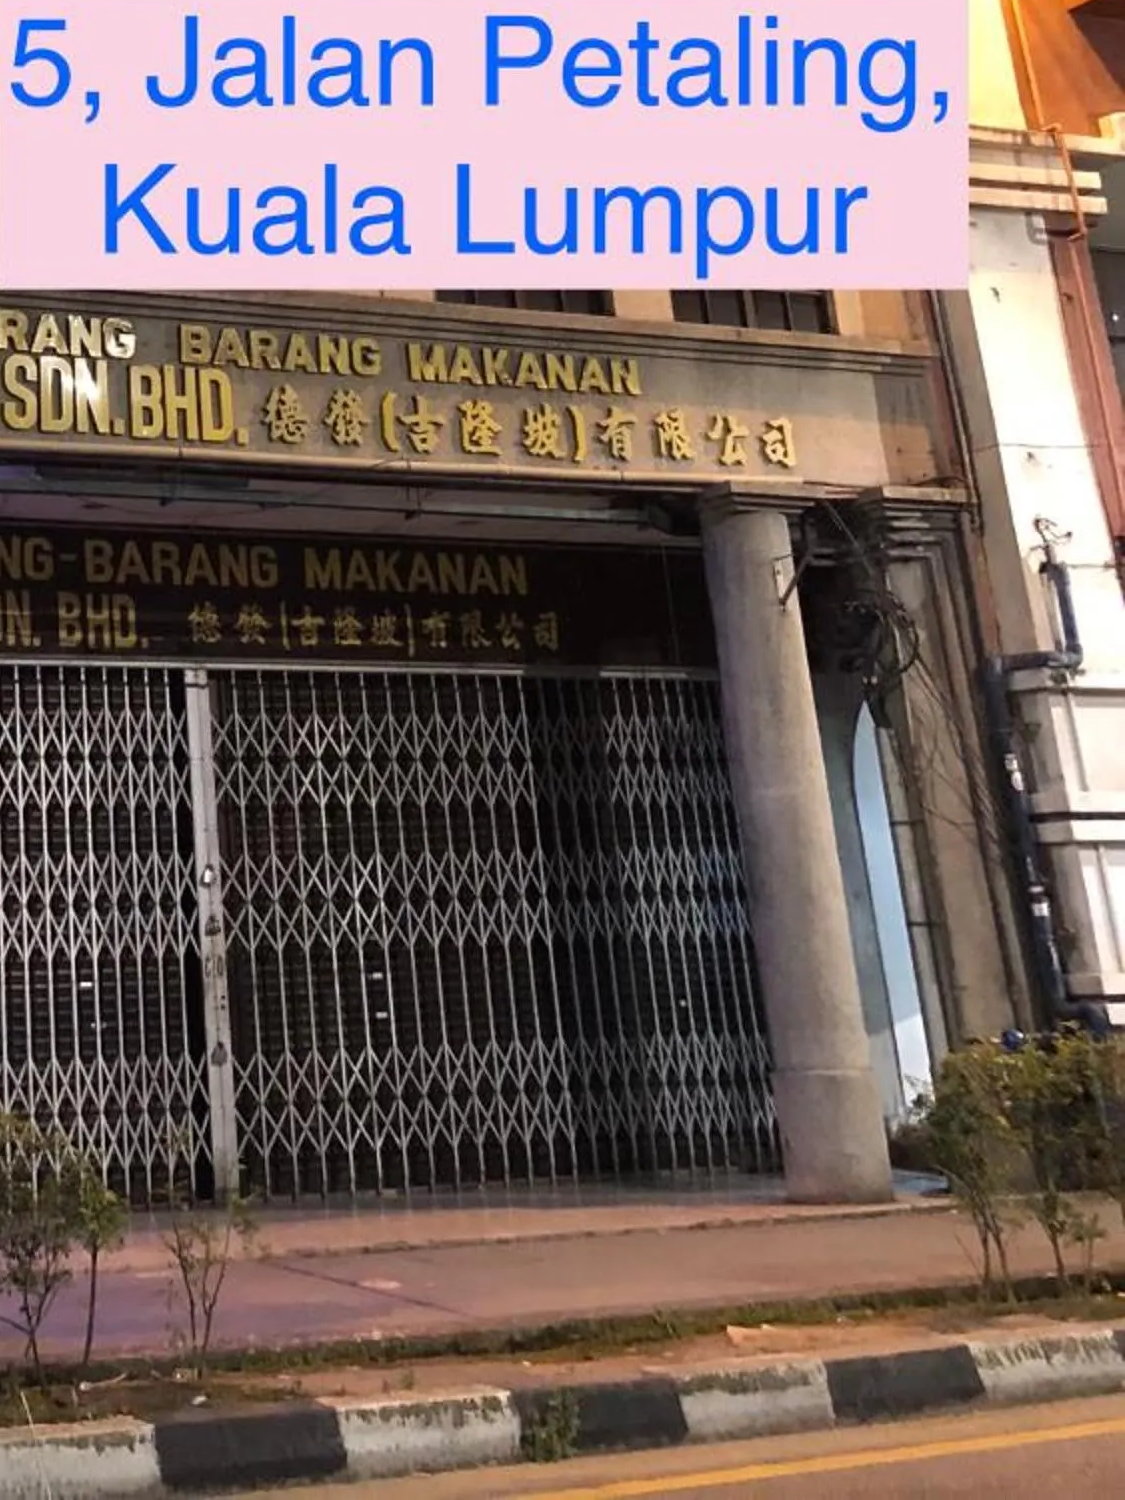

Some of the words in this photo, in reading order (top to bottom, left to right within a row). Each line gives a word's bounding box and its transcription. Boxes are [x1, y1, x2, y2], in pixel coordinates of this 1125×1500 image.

[178, 323, 382, 376] BARANG
[407, 341, 643, 397] MAKANAN
[304, 546, 529, 597] MAKANAN
[57, 593, 150, 650] BHD.
